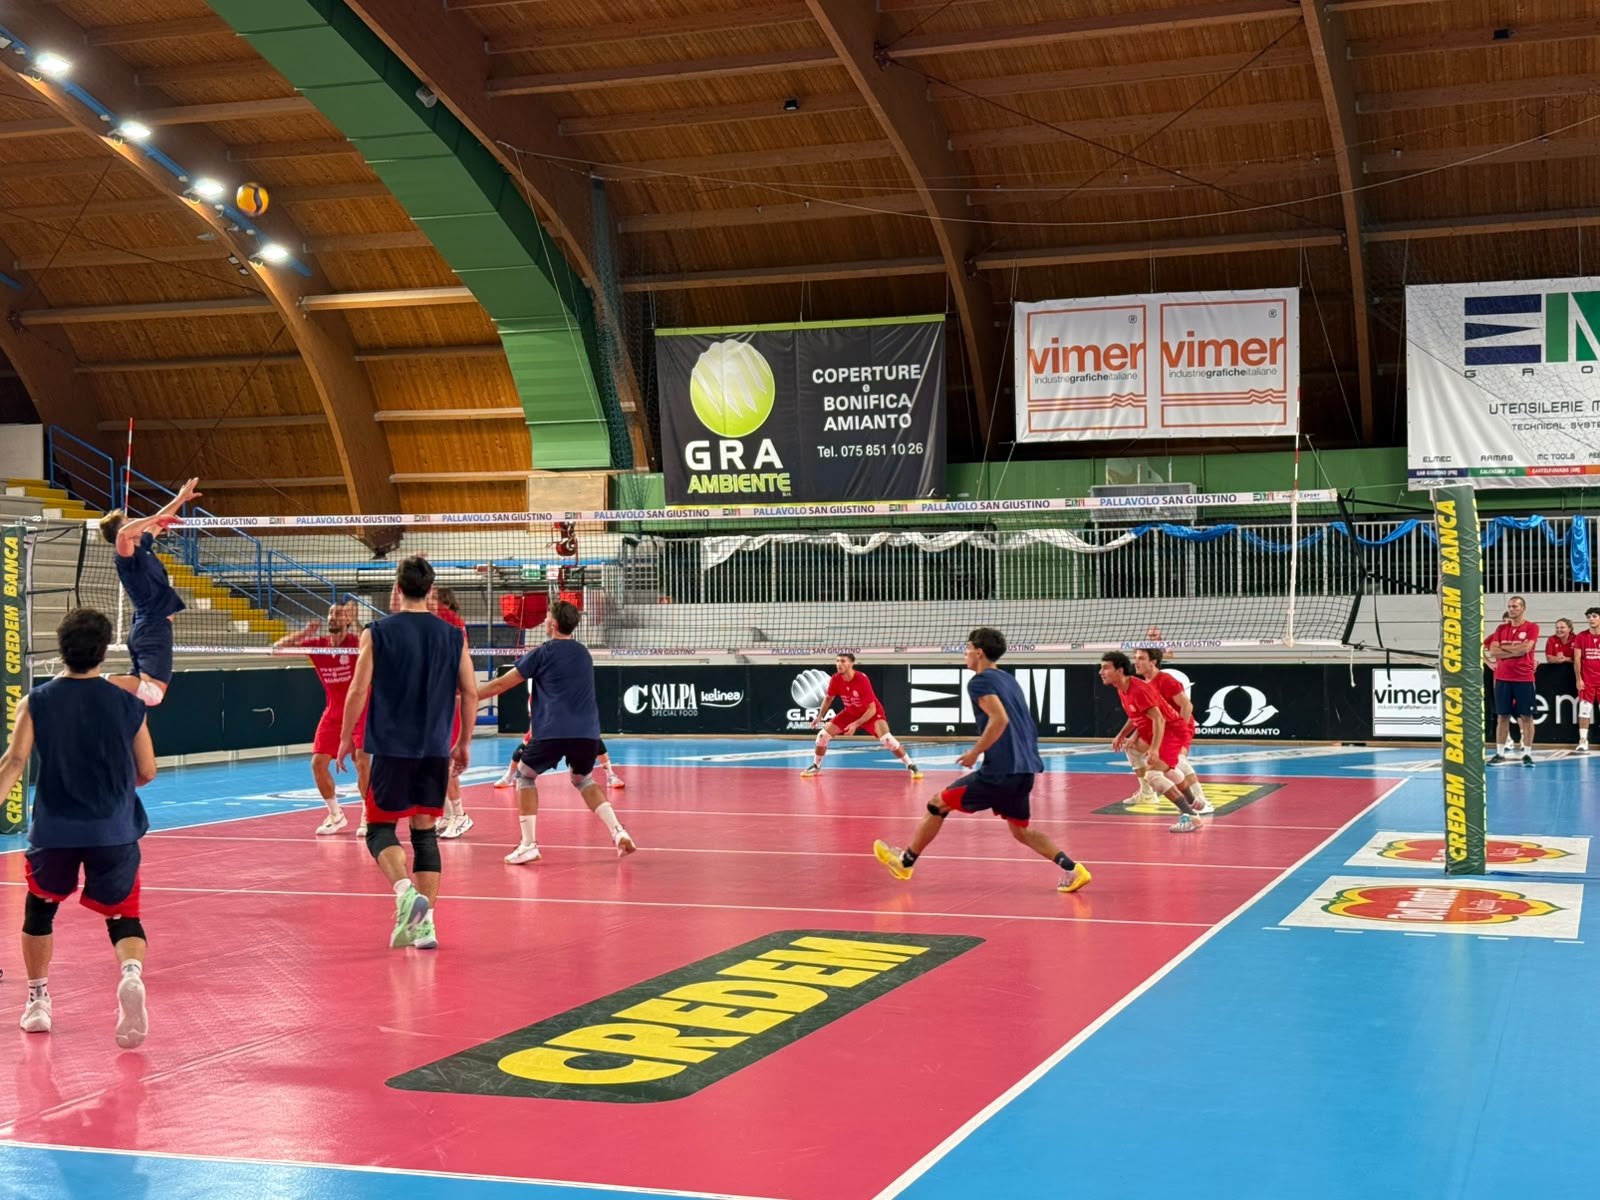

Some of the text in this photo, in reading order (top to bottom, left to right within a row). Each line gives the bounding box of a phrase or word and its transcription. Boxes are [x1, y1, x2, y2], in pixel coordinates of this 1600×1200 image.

[1028, 337, 1145, 374] vimer
[1161, 330, 1286, 368] vimer
[812, 364, 921, 384] COPERTURE
[862, 384, 870, 393] e
[823, 393, 912, 412] BONIFICA
[1489, 401, 1583, 415] UTENSILERIE
[823, 413, 912, 432] AMIANTO
[1512, 422, 1565, 431] TECHNICAL
[817, 442, 924, 458] Tel. 075 851 10 26
[687, 472, 791, 494] AMBIENTE
[202, 518, 219, 526] SAN
[220, 517, 258, 526] GIUSTINO
[296, 516, 343, 525] PALLAVOLO
[344, 516, 361, 525] SAN
[362, 515, 402, 524] GIUSTINO
[442, 513, 490, 522] PALLAVOLO
[492, 513, 510, 522] SAN
[511, 512, 552, 521] GIUSTINO
[594, 511, 644, 520] PALLAVOLO
[647, 510, 665, 519] SAN
[666, 508, 709, 518] GIUSTINO
[753, 506, 806, 516] PALLAVOLO
[809, 506, 827, 515] SAN
[829, 504, 875, 514] GIUSTINO
[921, 502, 978, 512] PALLAVOLO
[980, 501, 1000, 510] SAN
[1002, 500, 1050, 509] GIUSTINO
[1100, 496, 1159, 506] PALLAVOLO
[1161, 495, 1183, 505] SAN
[1185, 494, 1237, 504] GIUSTINO
[1436, 500, 1460, 576] BANCA
[4, 536, 21, 674] CREDEM BANCA
[1442, 586, 1462, 673] CREDEM
[1120, 641, 1165, 649] PALLAVOLO
[1184, 640, 1221, 648] GIUSTINO
[651, 683, 698, 710] SALPA
[701, 688, 742, 702] kelinea
[1374, 684, 1440, 704] vimer
[651, 709, 698, 717] SPECIAL FOOD
[1195, 727, 1280, 735] BONIFICA AMIANTO
[1445, 687, 1468, 862] CREDEM BANCA
[497, 936, 930, 1085] CREDEM
